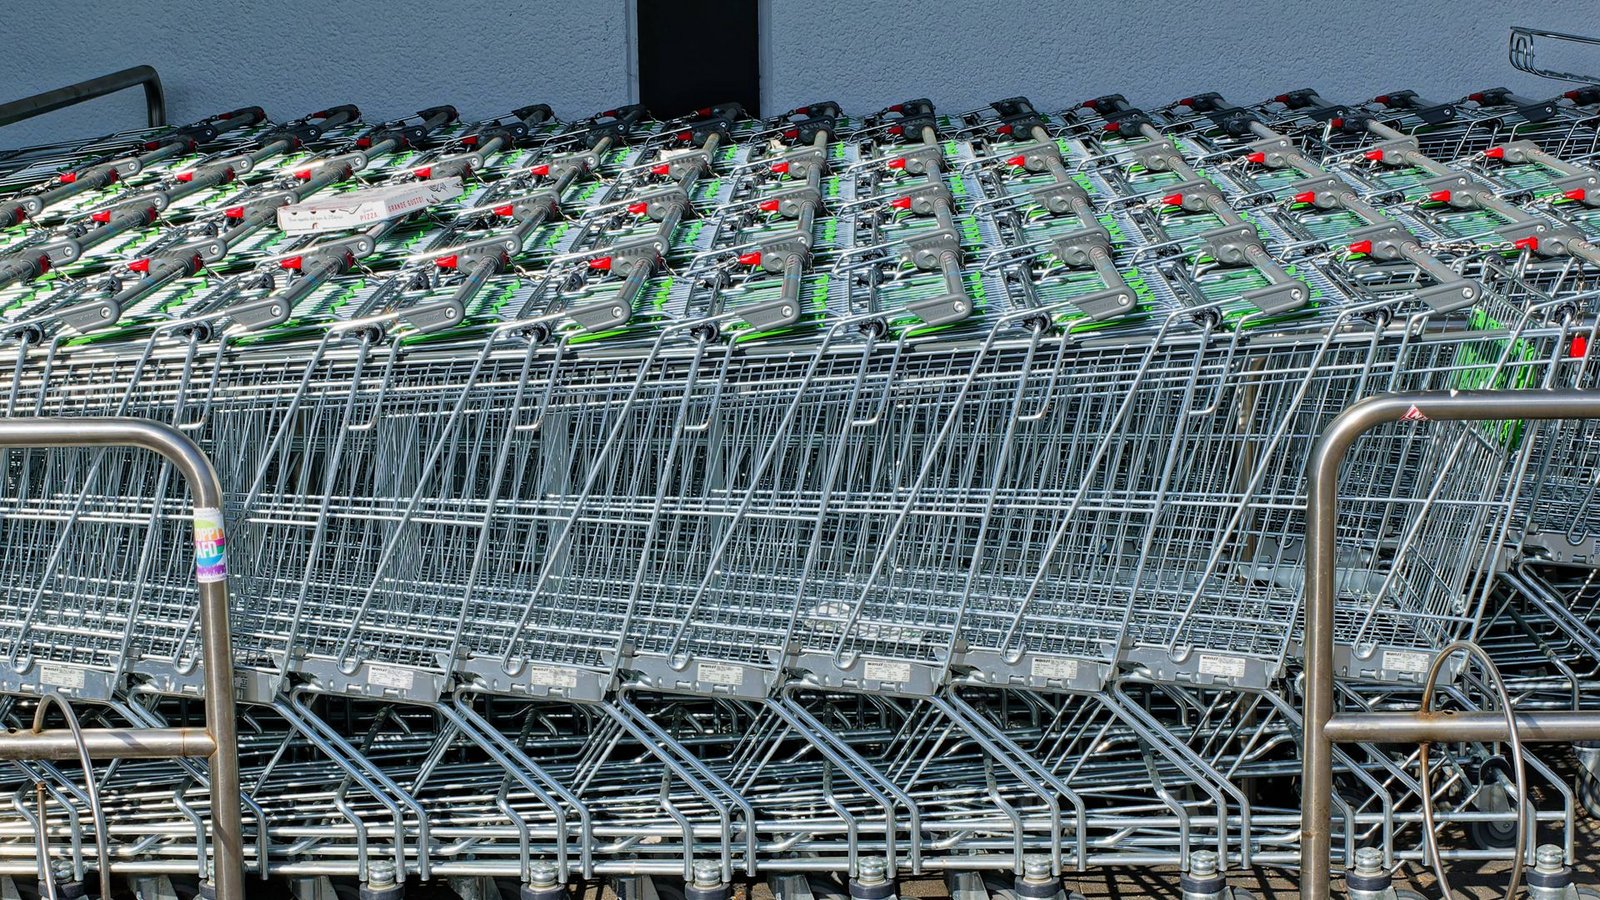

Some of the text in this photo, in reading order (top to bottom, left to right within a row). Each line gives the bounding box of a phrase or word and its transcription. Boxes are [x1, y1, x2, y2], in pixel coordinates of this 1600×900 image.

[387, 200, 407, 213] GRANDE
[360, 211, 378, 221] PIZZA
[197, 541, 217, 558] AFD
